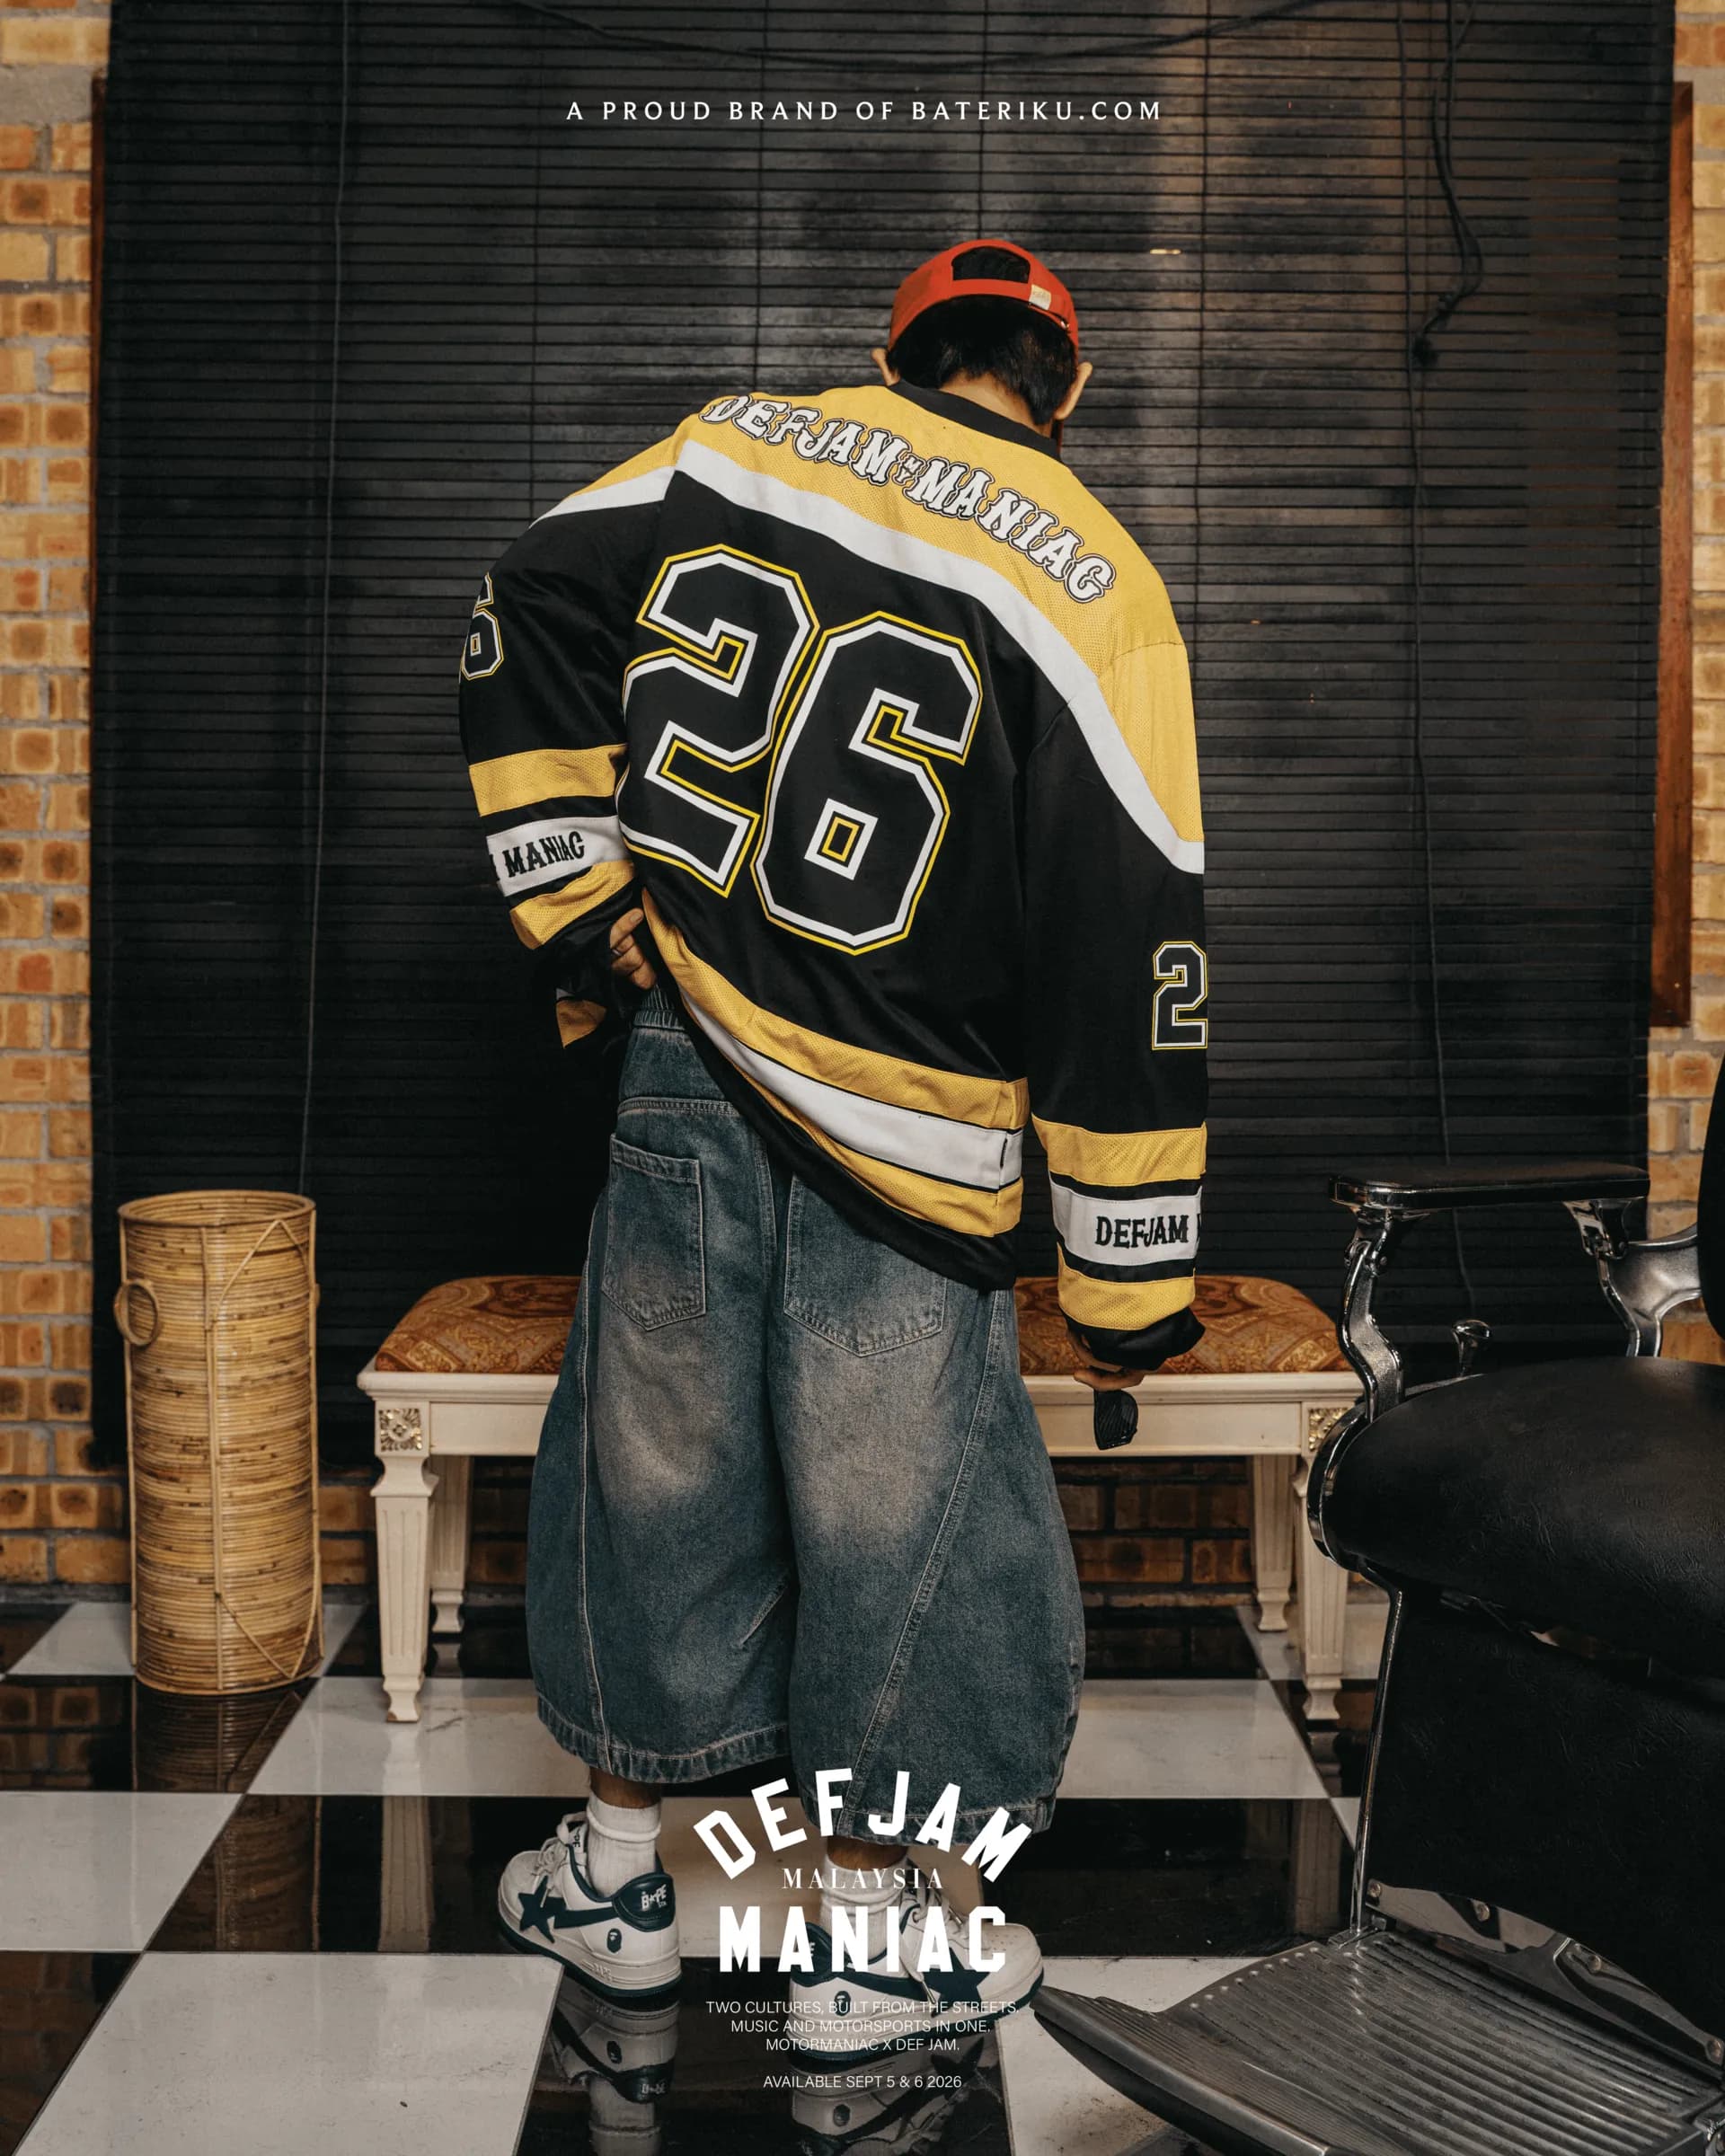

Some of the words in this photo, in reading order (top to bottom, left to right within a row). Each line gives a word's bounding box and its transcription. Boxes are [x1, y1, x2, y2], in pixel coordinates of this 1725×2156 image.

[699, 393, 911, 486] DEFJAM
[903, 455, 1116, 603] MANIAC
[615, 543, 984, 956] 26
[501, 830, 585, 879] MANIAC
[1152, 941, 1208, 1050] 2
[1094, 1214, 1190, 1249] DEFJAM
